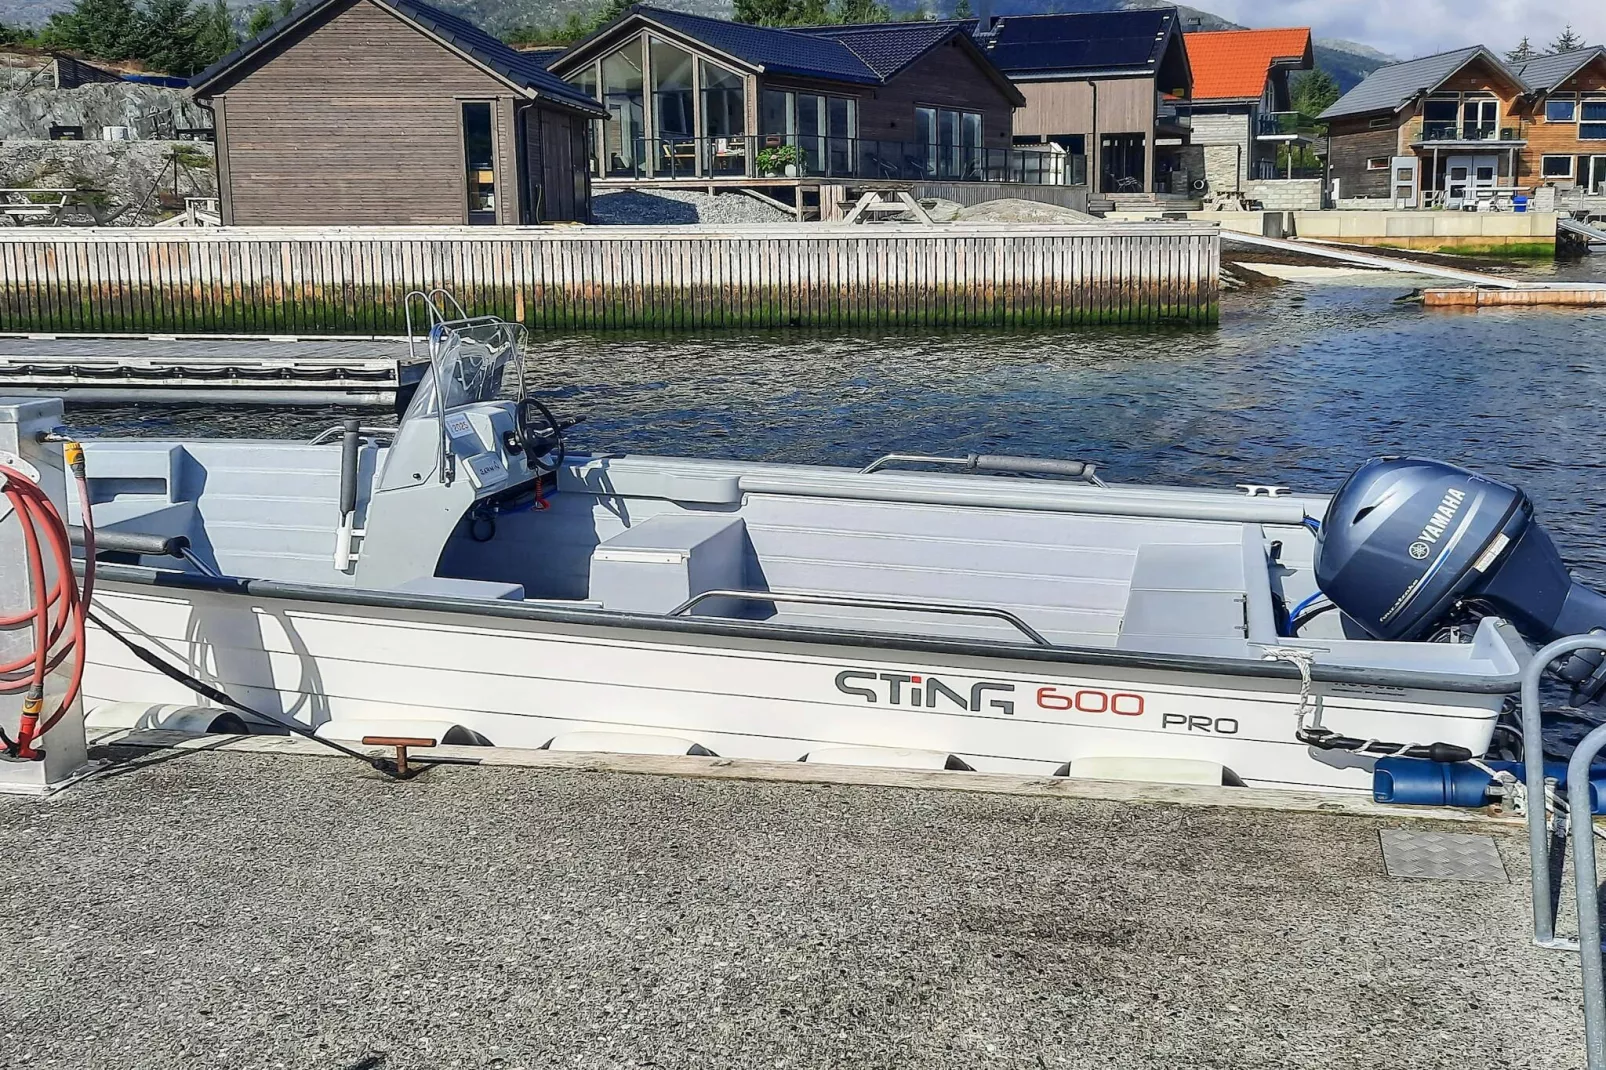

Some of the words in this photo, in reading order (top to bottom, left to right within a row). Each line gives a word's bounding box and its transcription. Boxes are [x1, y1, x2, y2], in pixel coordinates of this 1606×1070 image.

[1418, 488, 1466, 544] YAMAHA
[1036, 687, 1145, 717] 600
[1162, 712, 1239, 735] PRO
